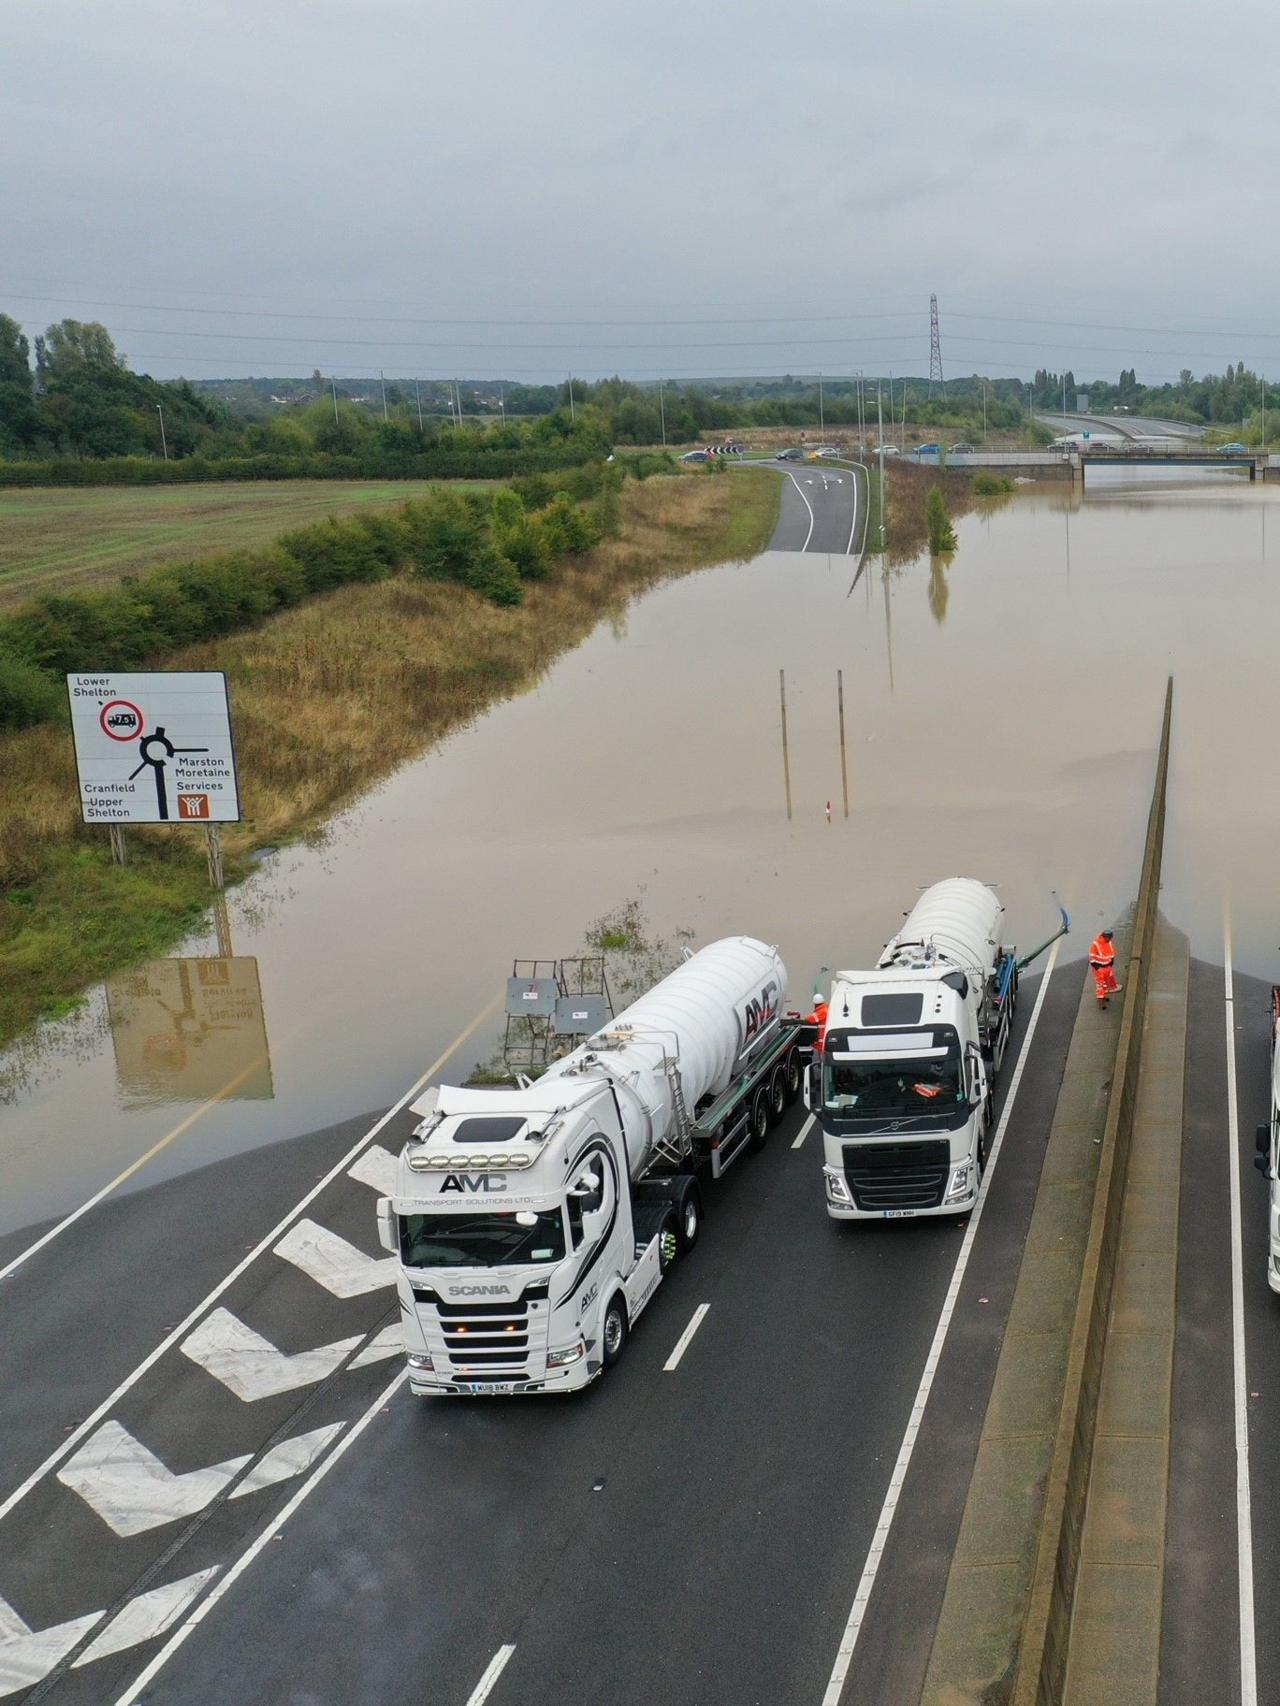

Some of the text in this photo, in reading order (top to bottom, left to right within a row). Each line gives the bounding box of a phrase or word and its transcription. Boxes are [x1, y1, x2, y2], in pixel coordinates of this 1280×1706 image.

[76, 676, 110, 686] Lower
[73, 687, 117, 696] Shelton
[179, 757, 225, 766] Marston
[175, 768, 231, 777] Moretaine
[84, 783, 136, 793] Cranfield
[176, 781, 224, 790] Services
[90, 797, 123, 807] Upper
[87, 808, 130, 817] Shelton
[438, 1173, 507, 1193] AMC
[414, 1199, 463, 1207] TRANSPORT
[466, 1198, 513, 1206] SOLUTIONS
[448, 1285, 511, 1296] SCANIA
